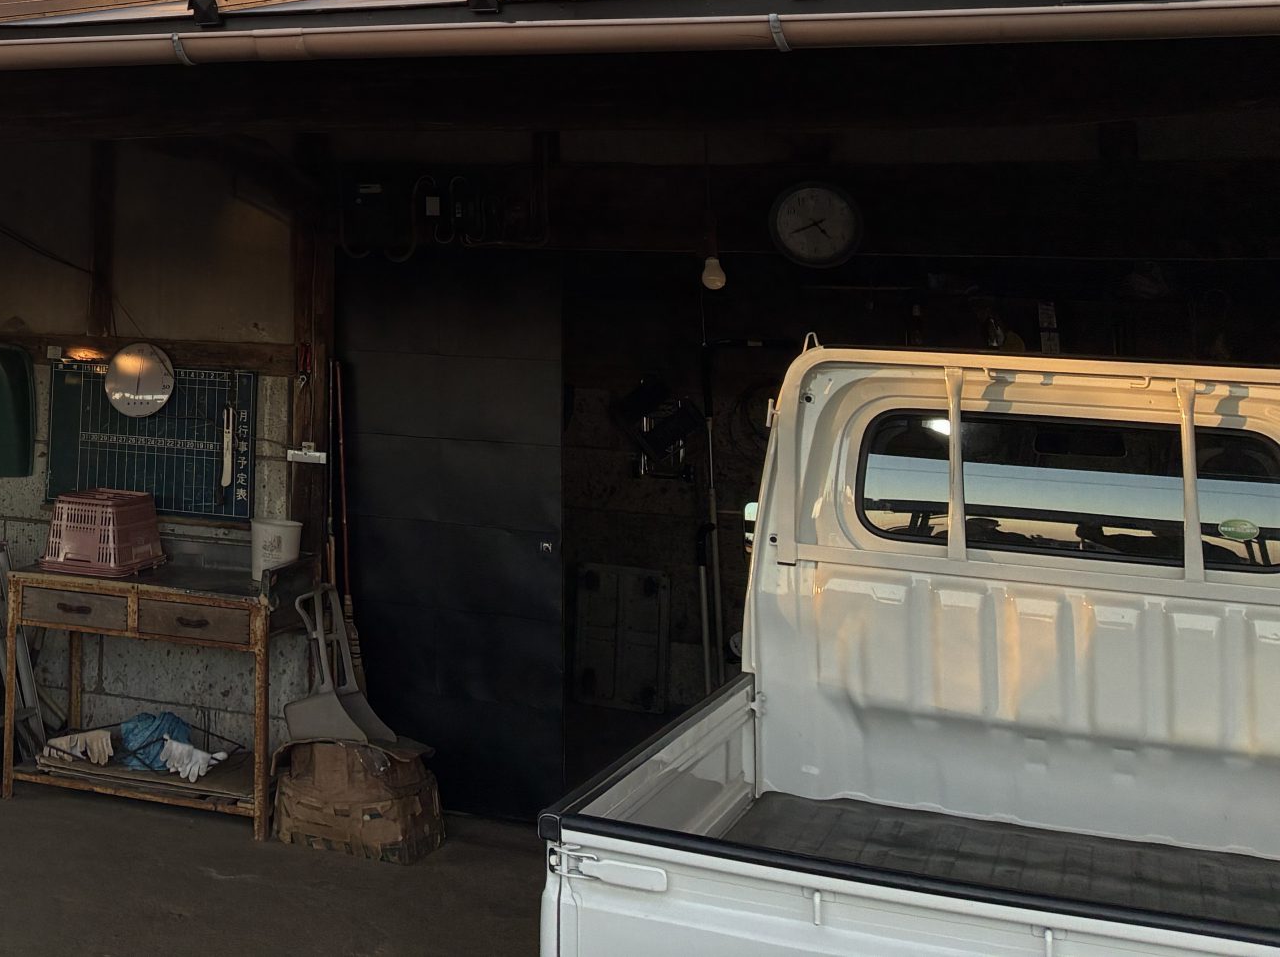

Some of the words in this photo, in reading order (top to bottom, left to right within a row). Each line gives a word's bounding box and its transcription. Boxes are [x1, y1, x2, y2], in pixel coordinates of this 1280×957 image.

[235, 409, 249, 501] 月行事予定表
